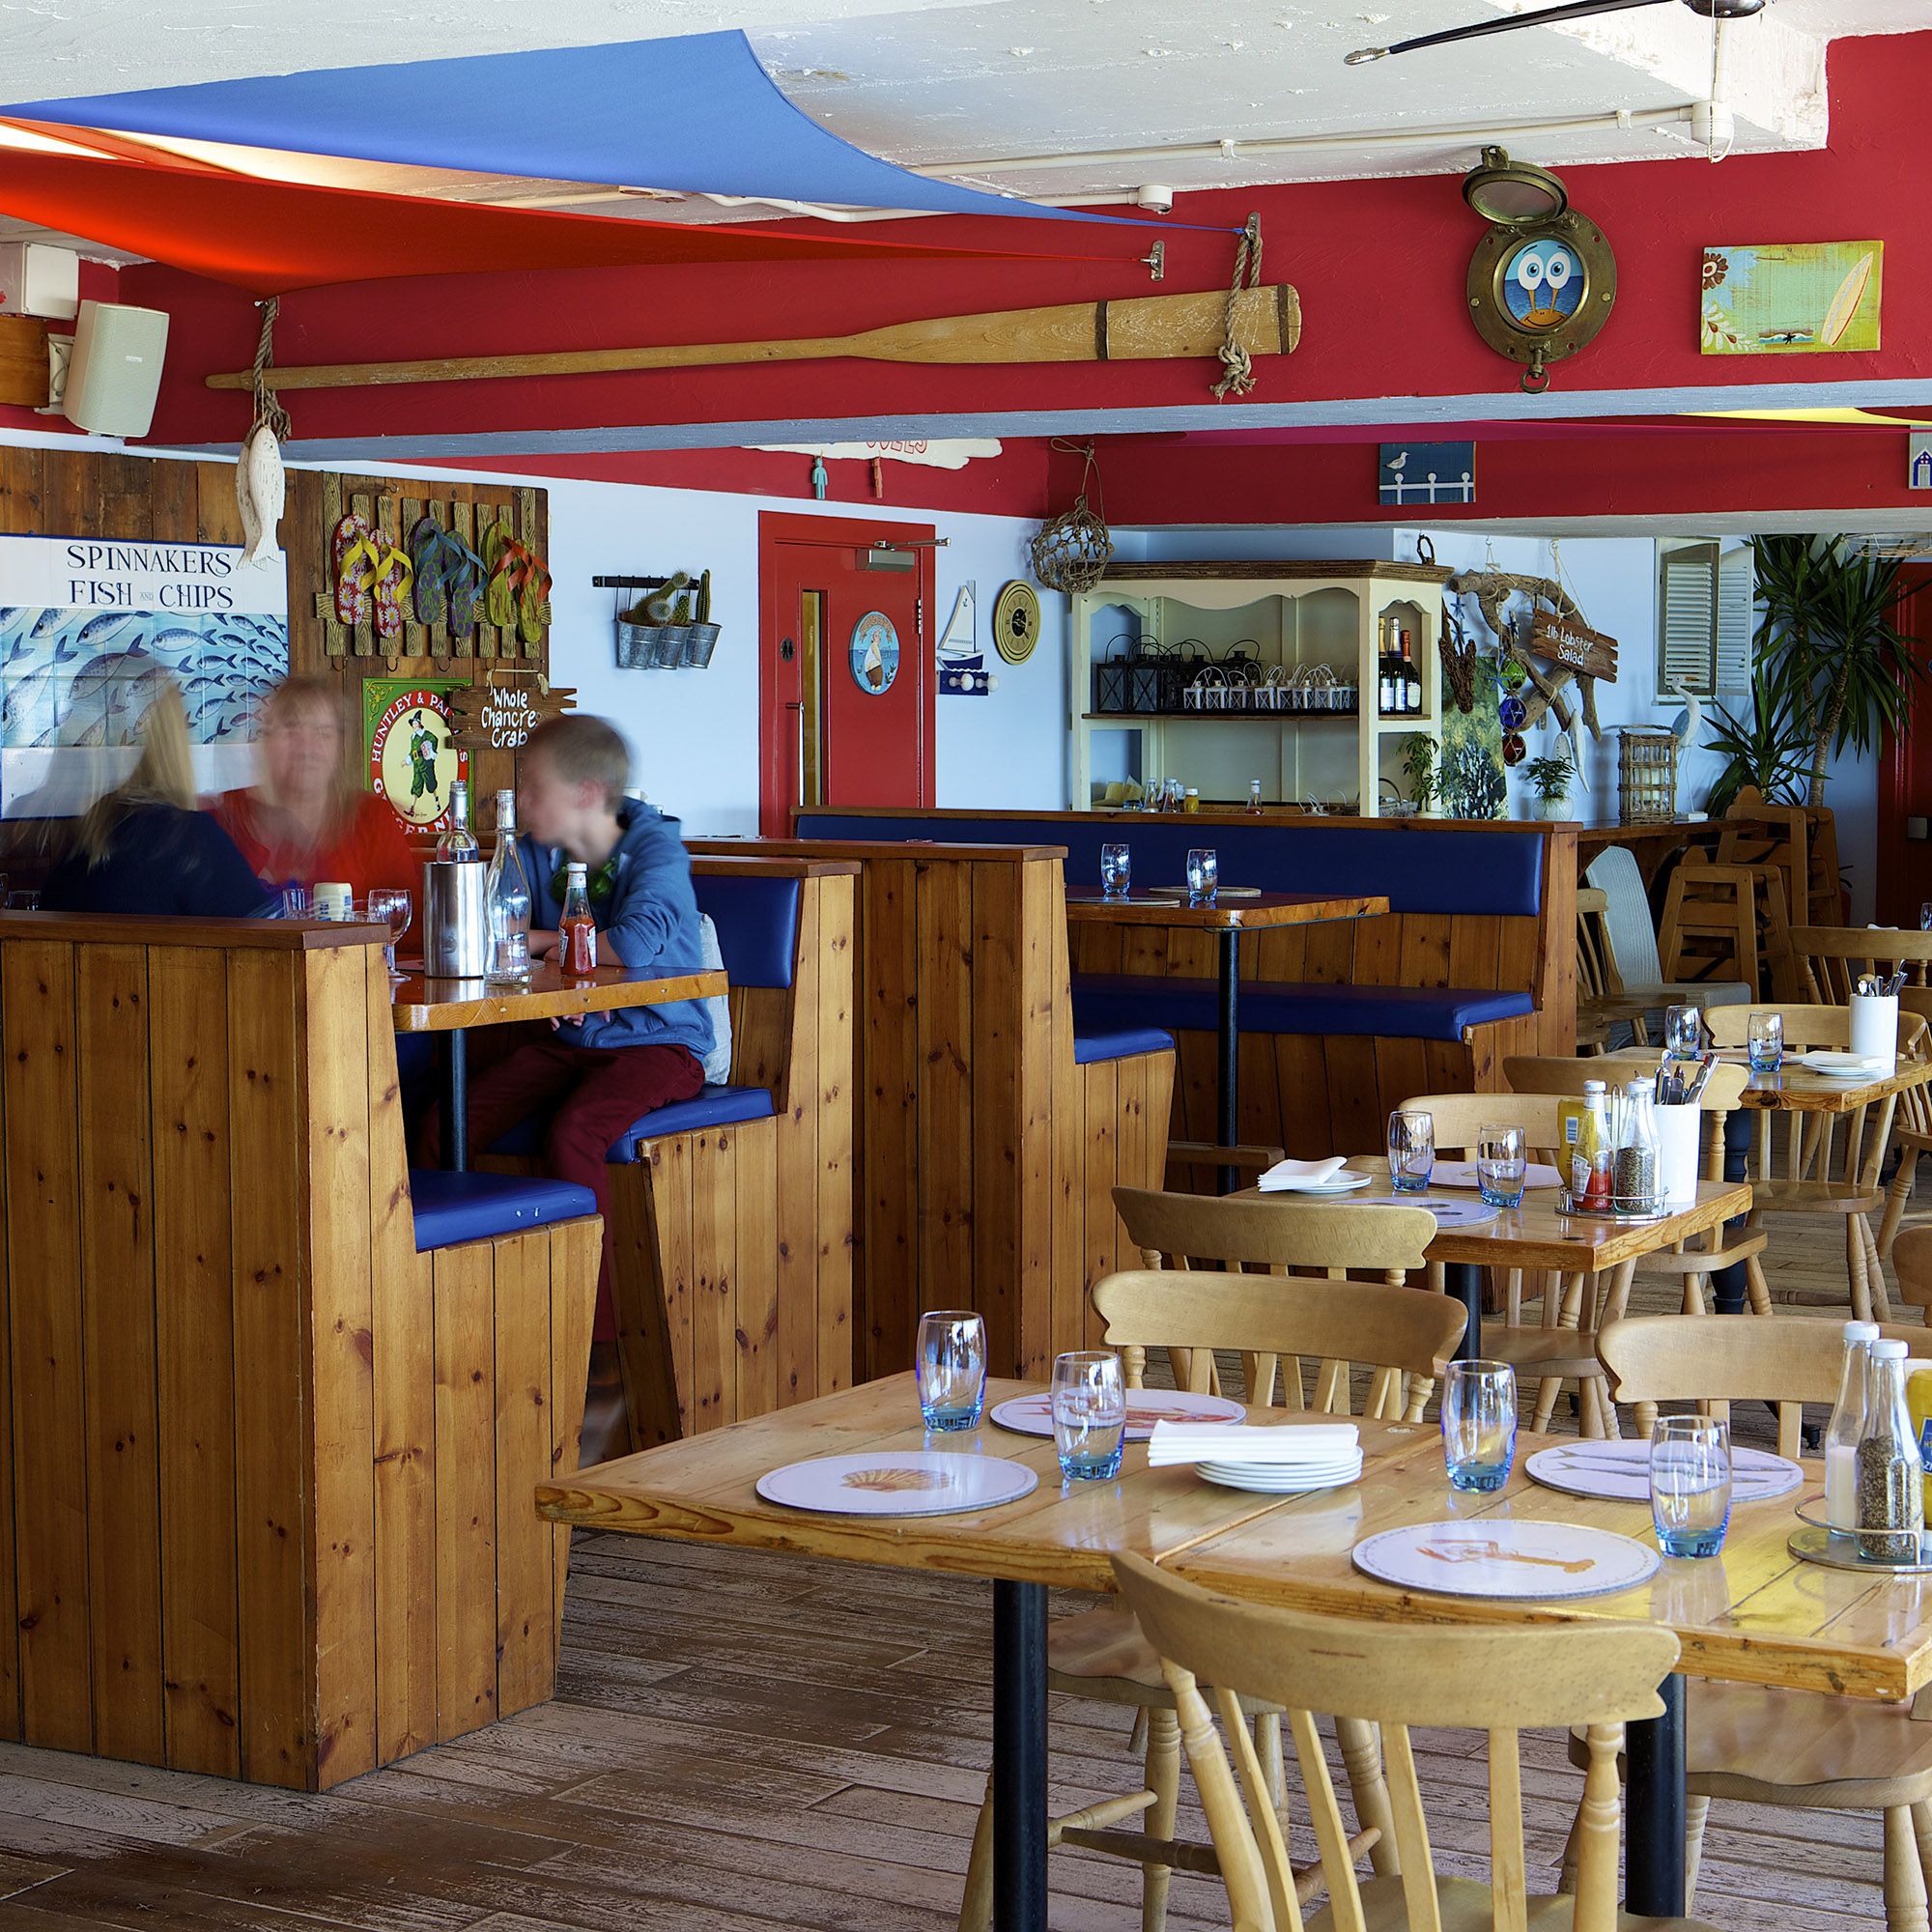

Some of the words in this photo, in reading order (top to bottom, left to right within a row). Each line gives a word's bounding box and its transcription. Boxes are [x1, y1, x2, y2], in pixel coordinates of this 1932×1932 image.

[67, 544, 232, 578] SPINNAKERS
[68, 580, 132, 606] FISH
[138, 591, 155, 602] AND
[159, 583, 234, 610] CHIPS
[1560, 626, 1594, 652] Lobster
[1557, 643, 1584, 667] Salad
[493, 687, 528, 709] Whole
[371, 693, 412, 763] HUNTLEY
[416, 692, 425, 705] &
[481, 706, 537, 728] Chancre
[491, 727, 528, 749] Crab
